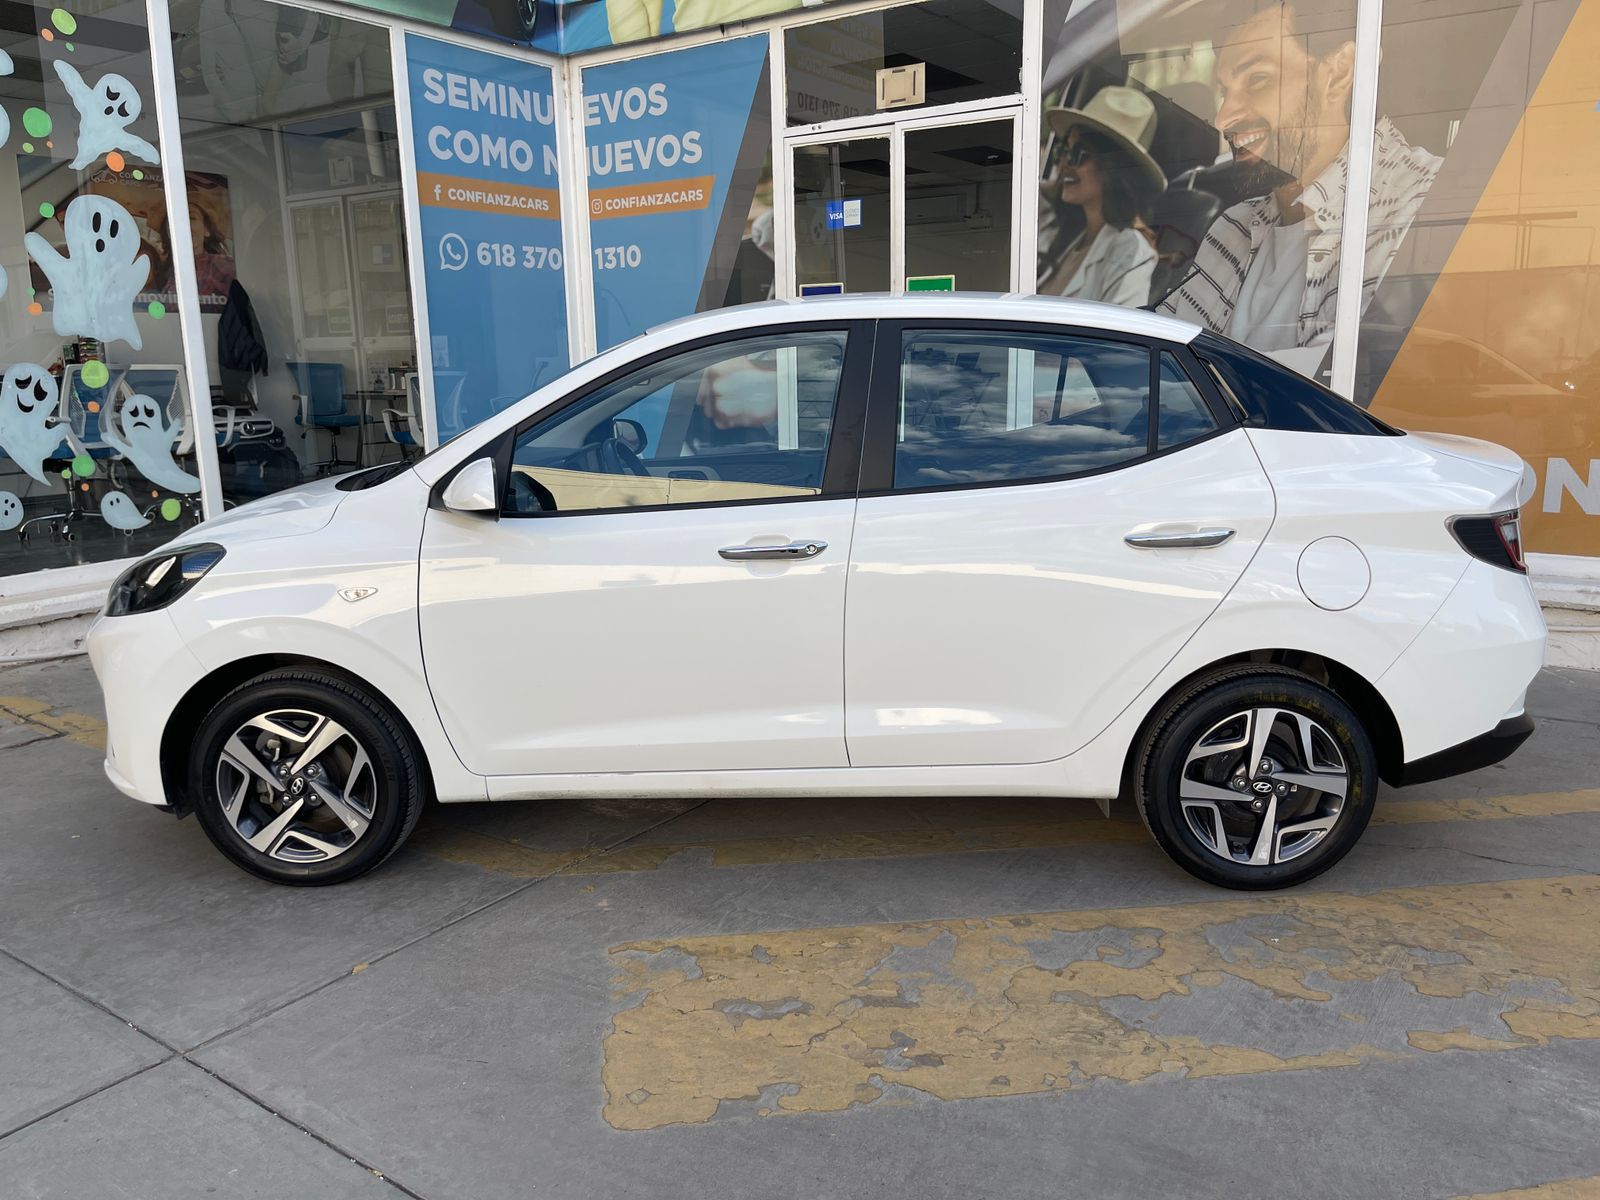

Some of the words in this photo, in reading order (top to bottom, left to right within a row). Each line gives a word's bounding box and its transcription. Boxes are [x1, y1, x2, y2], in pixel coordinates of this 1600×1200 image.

[428, 125, 534, 173] COMO
[447, 187, 549, 211] CONFIANZACARS
[605, 189, 704, 211] CONFIANZACARS
[829, 212, 844, 221] VISA
[476, 242, 516, 267] 618
[522, 246, 562, 270] 370
[594, 245, 642, 270] 1310
